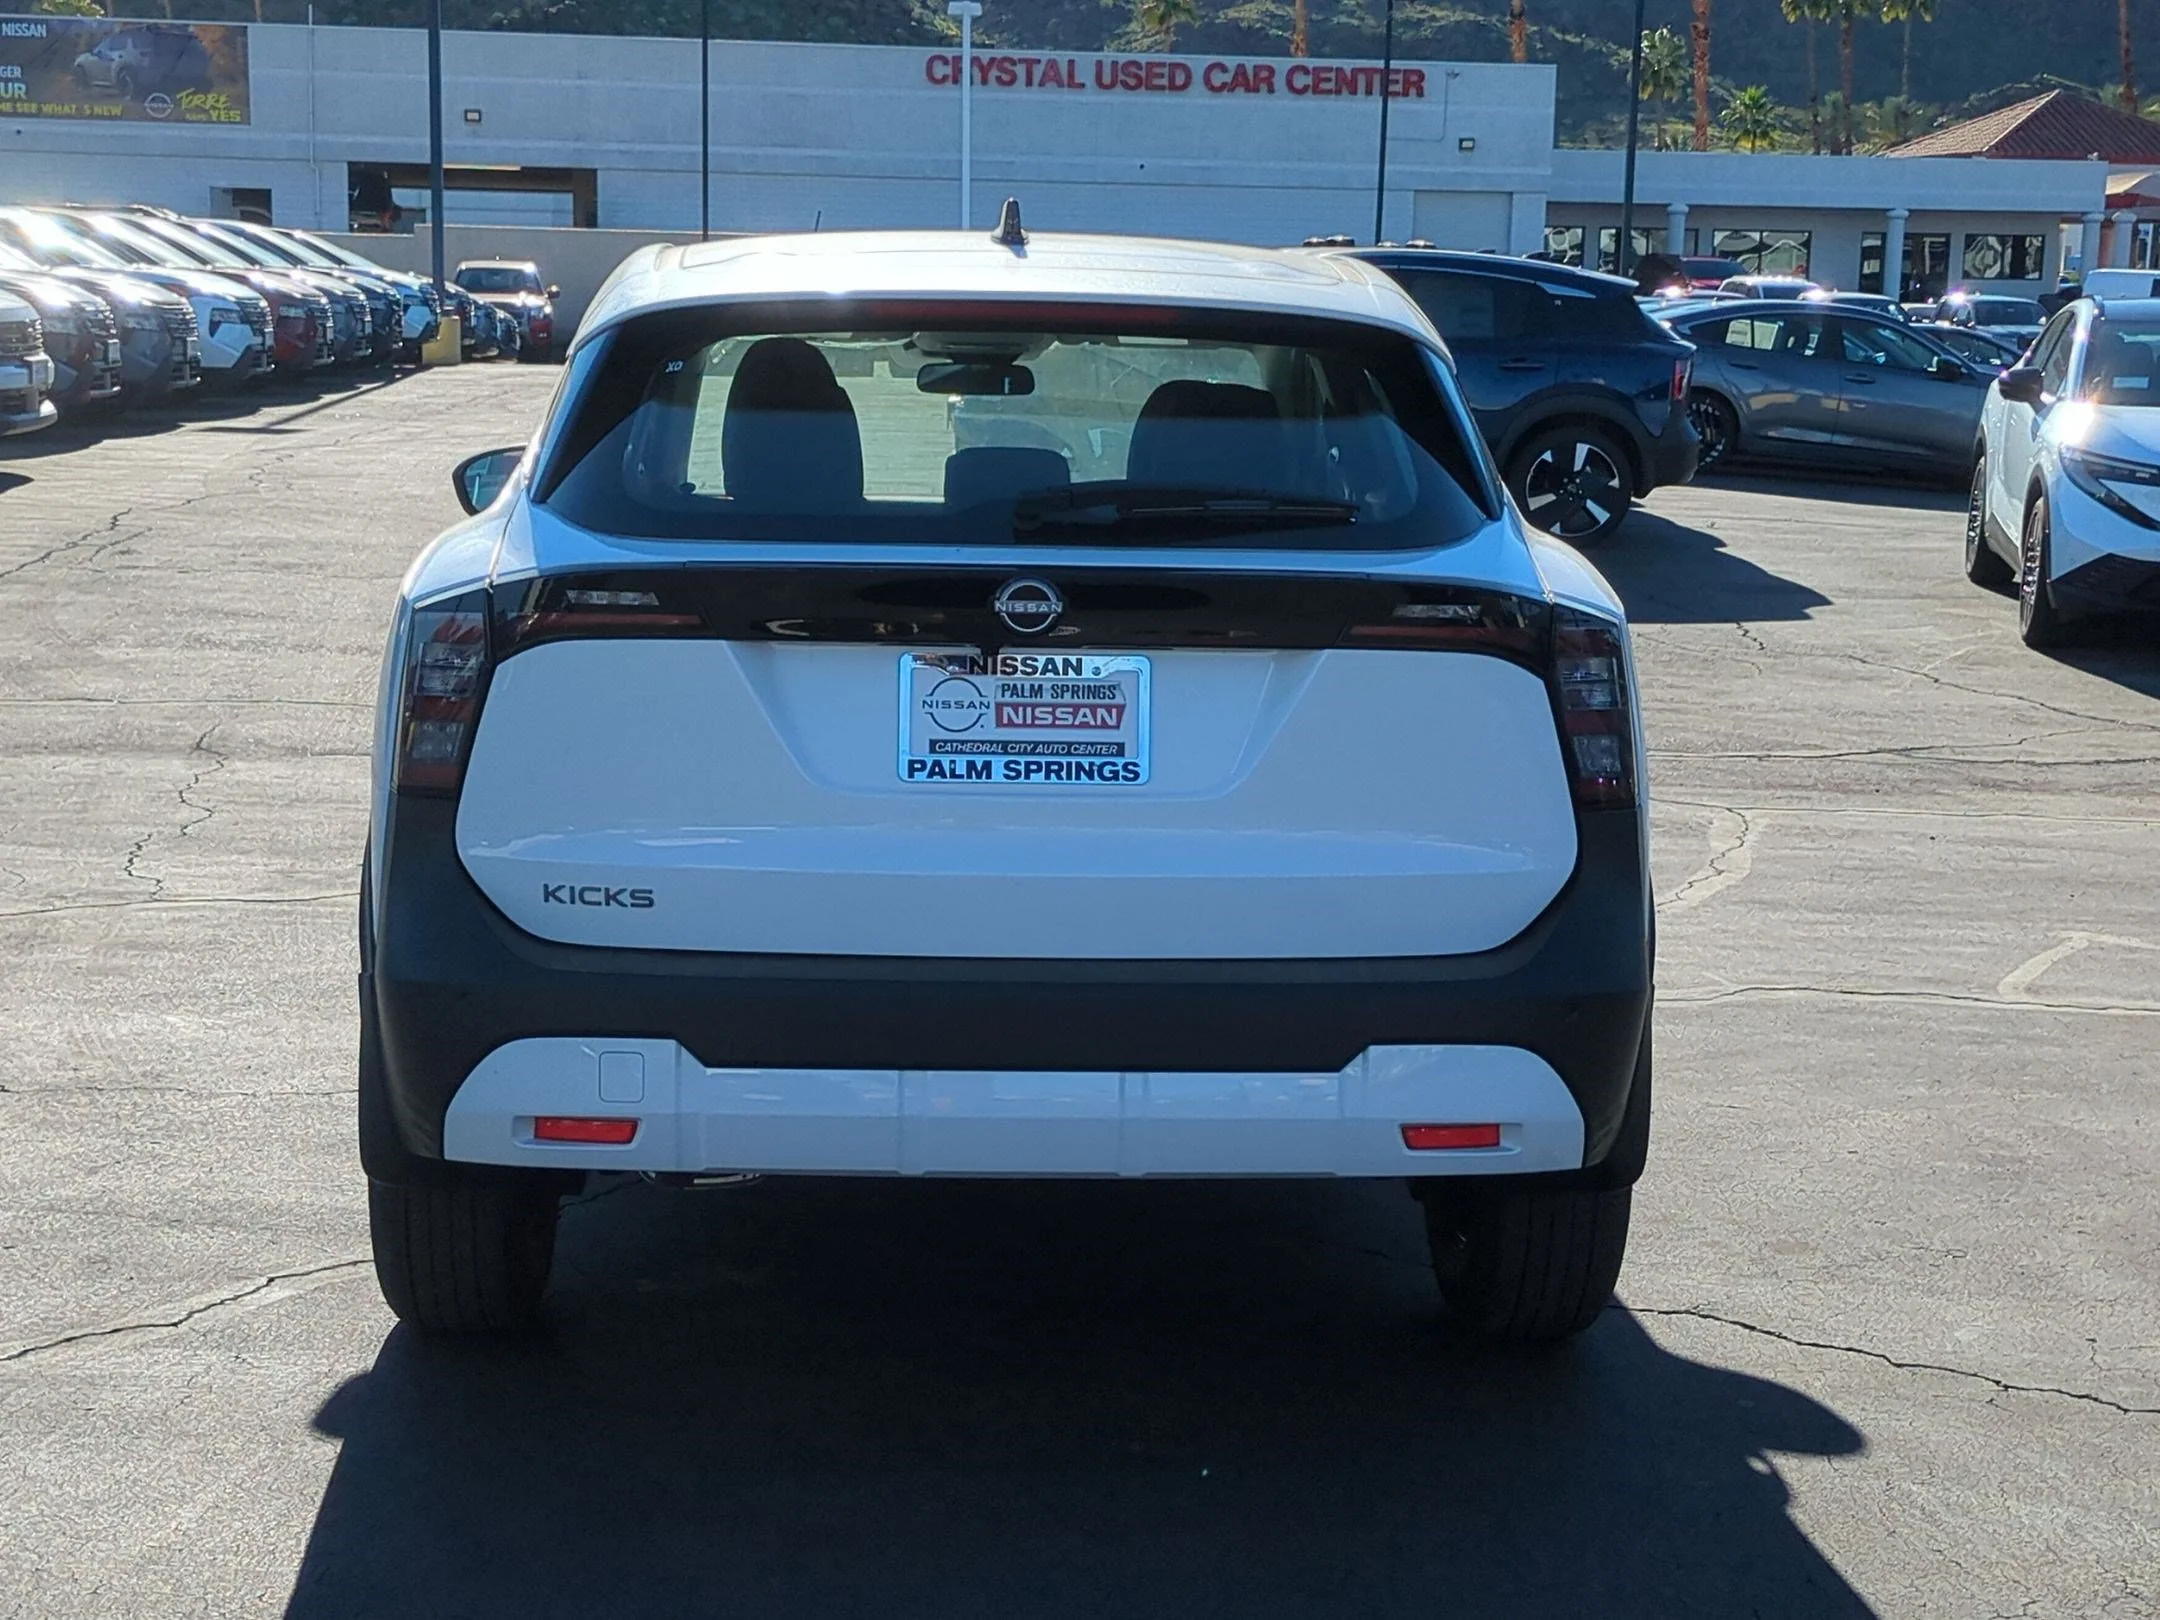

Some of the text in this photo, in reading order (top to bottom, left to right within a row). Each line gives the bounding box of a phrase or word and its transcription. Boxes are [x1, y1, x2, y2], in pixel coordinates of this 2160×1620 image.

[2, 22, 47, 38] NISSAN
[1094, 59, 1193, 93] USED
[1203, 62, 1276, 95] CAR
[1285, 64, 1426, 99] CENTER
[41, 103, 93, 116] WHATS
[994, 600, 1063, 613] NISSAN
[968, 655, 1083, 676] NISSAN
[1001, 683, 1117, 700] PALM SPRINGS
[922, 699, 990, 710] NISSAN
[1002, 706, 1118, 726] NISSAN
[935, 742, 1118, 756] CATHEDRAL CITY AUTO CENTER
[907, 759, 1141, 782] PALM SPRINGS
[543, 883, 655, 908] KICKS
